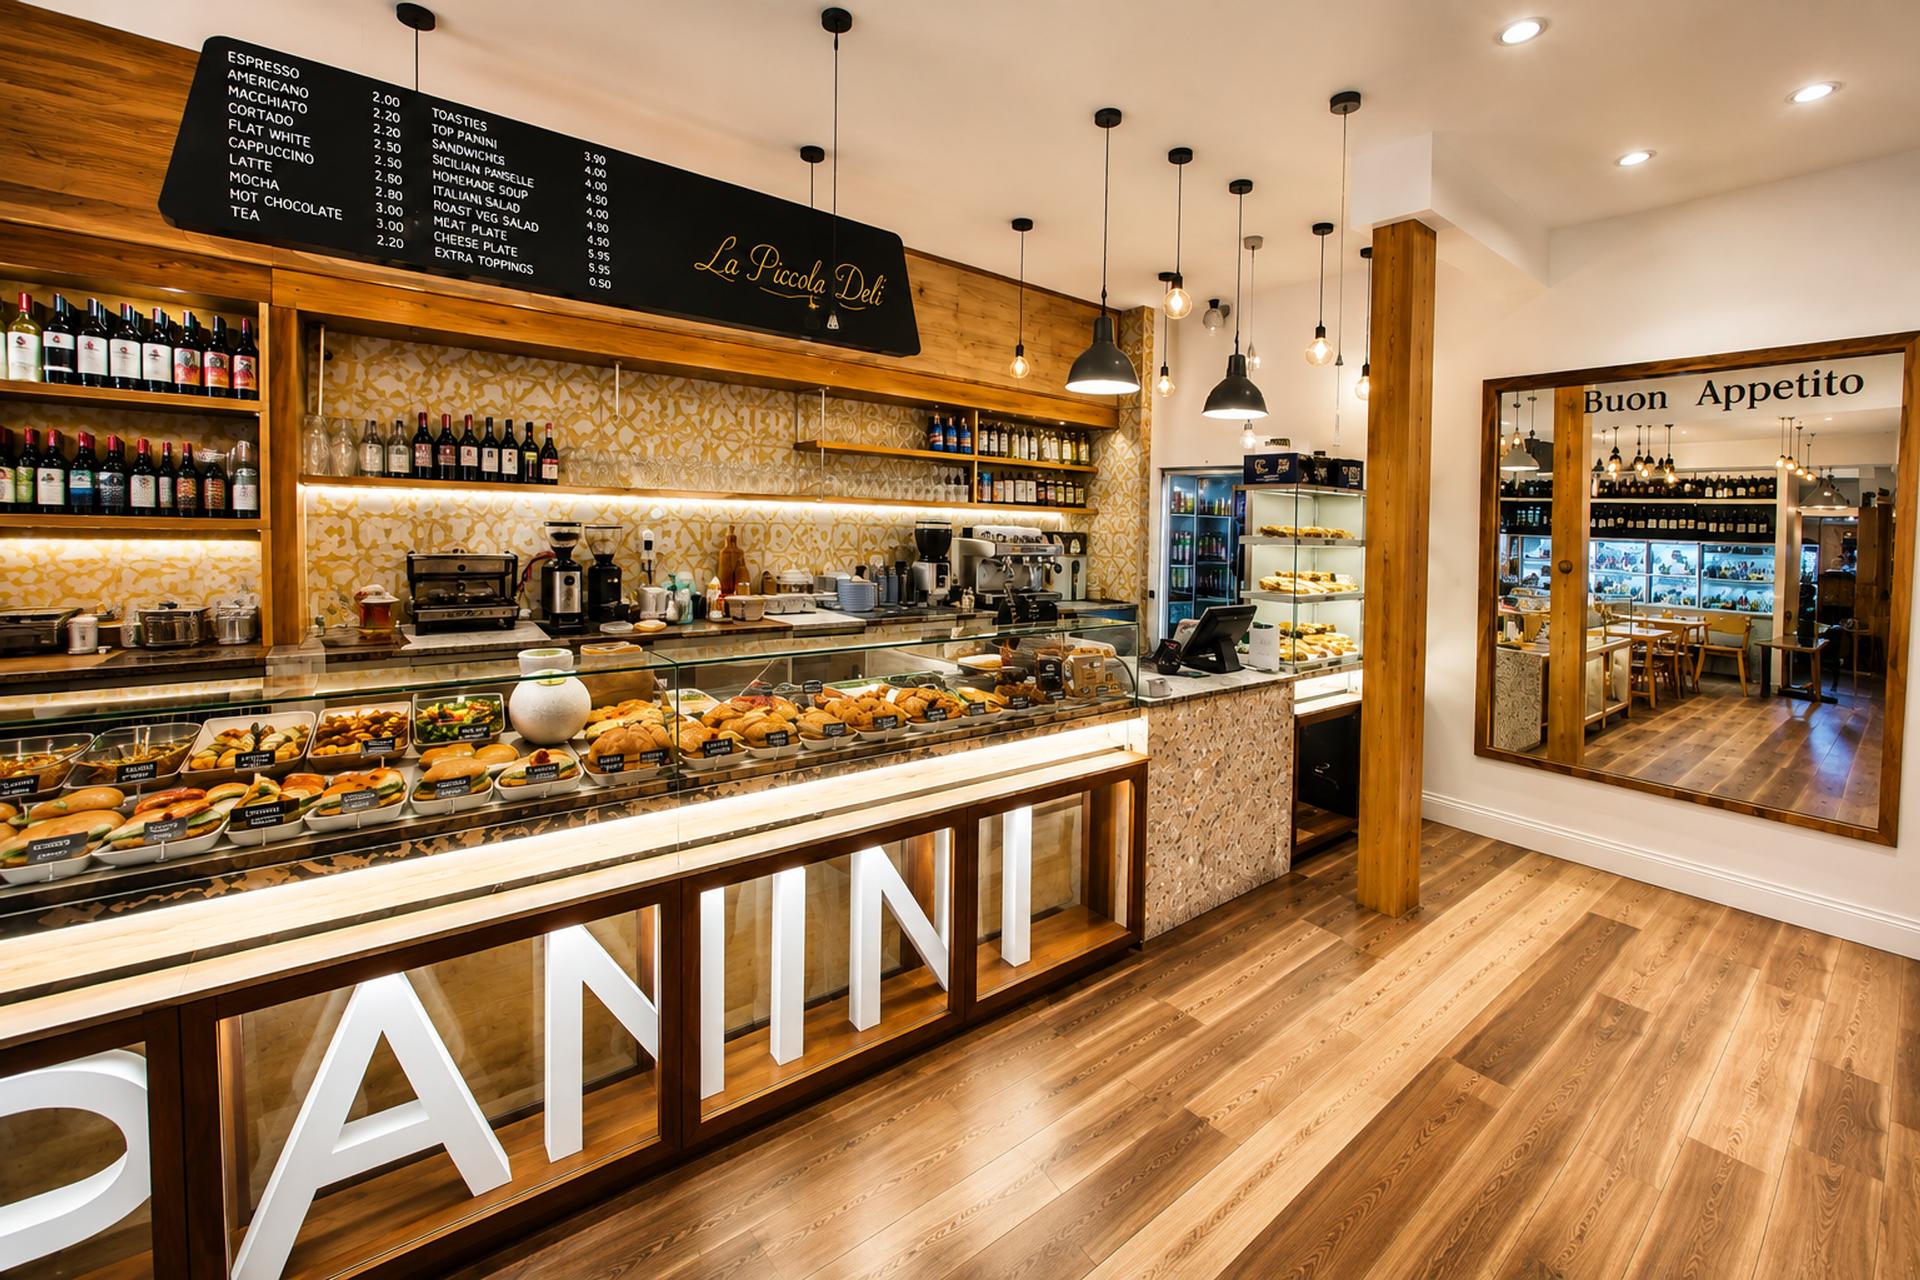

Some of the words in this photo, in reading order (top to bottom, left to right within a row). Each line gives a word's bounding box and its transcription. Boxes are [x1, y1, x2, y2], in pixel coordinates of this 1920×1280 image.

[227, 69, 309, 98] AMERICANO
[373, 107, 400, 123] 2.20
[228, 51, 300, 79] ESPRESSO
[373, 91, 400, 107] 2.00
[228, 85, 308, 114] MACCHIATO
[373, 123, 401, 138] 2.20
[228, 102, 294, 127] CORTADO
[374, 139, 401, 154] 2.50
[228, 136, 314, 164] CAPPUCCINO
[229, 118, 264, 136] FLAT
[269, 128, 311, 148] WHITE
[375, 155, 402, 169] 2.50
[432, 107, 487, 132] TOASTIES
[584, 151, 606, 165] 3.90
[432, 123, 454, 137] TOP
[457, 130, 497, 149] PANINI
[584, 166, 606, 178] 4.00
[229, 153, 272, 173] LATTE
[432, 154, 480, 175] SICILIAN
[230, 171, 280, 191] MOCHA
[376, 202, 403, 217] 3.00
[485, 196, 520, 213] SALAD
[499, 185, 528, 199] SOUP
[586, 207, 609, 220] 4.00
[585, 179, 607, 192] 4.00
[230, 205, 260, 221] TEA
[377, 235, 404, 249] 2.20
[264, 195, 342, 221] CHOCOLATE
[376, 218, 404, 233] 3.00
[434, 201, 472, 217] ROAST
[475, 210, 498, 223] VEG
[503, 215, 539, 232] SALAD
[434, 232, 479, 249] CHEESE
[483, 241, 518, 257] PLATE
[588, 262, 610, 275] 5.95
[471, 224, 507, 241] PLATE
[588, 249, 610, 262] 5.95
[435, 247, 473, 263] EXTRA
[477, 255, 534, 275] TOPPINGS
[589, 277, 611, 289] 0.50
[694, 236, 740, 282] La
[746, 243, 827, 297] Piccola
[835, 263, 887, 309] Deli
[1584, 390, 1668, 414] Buon
[1696, 369, 1864, 411] Appetito
